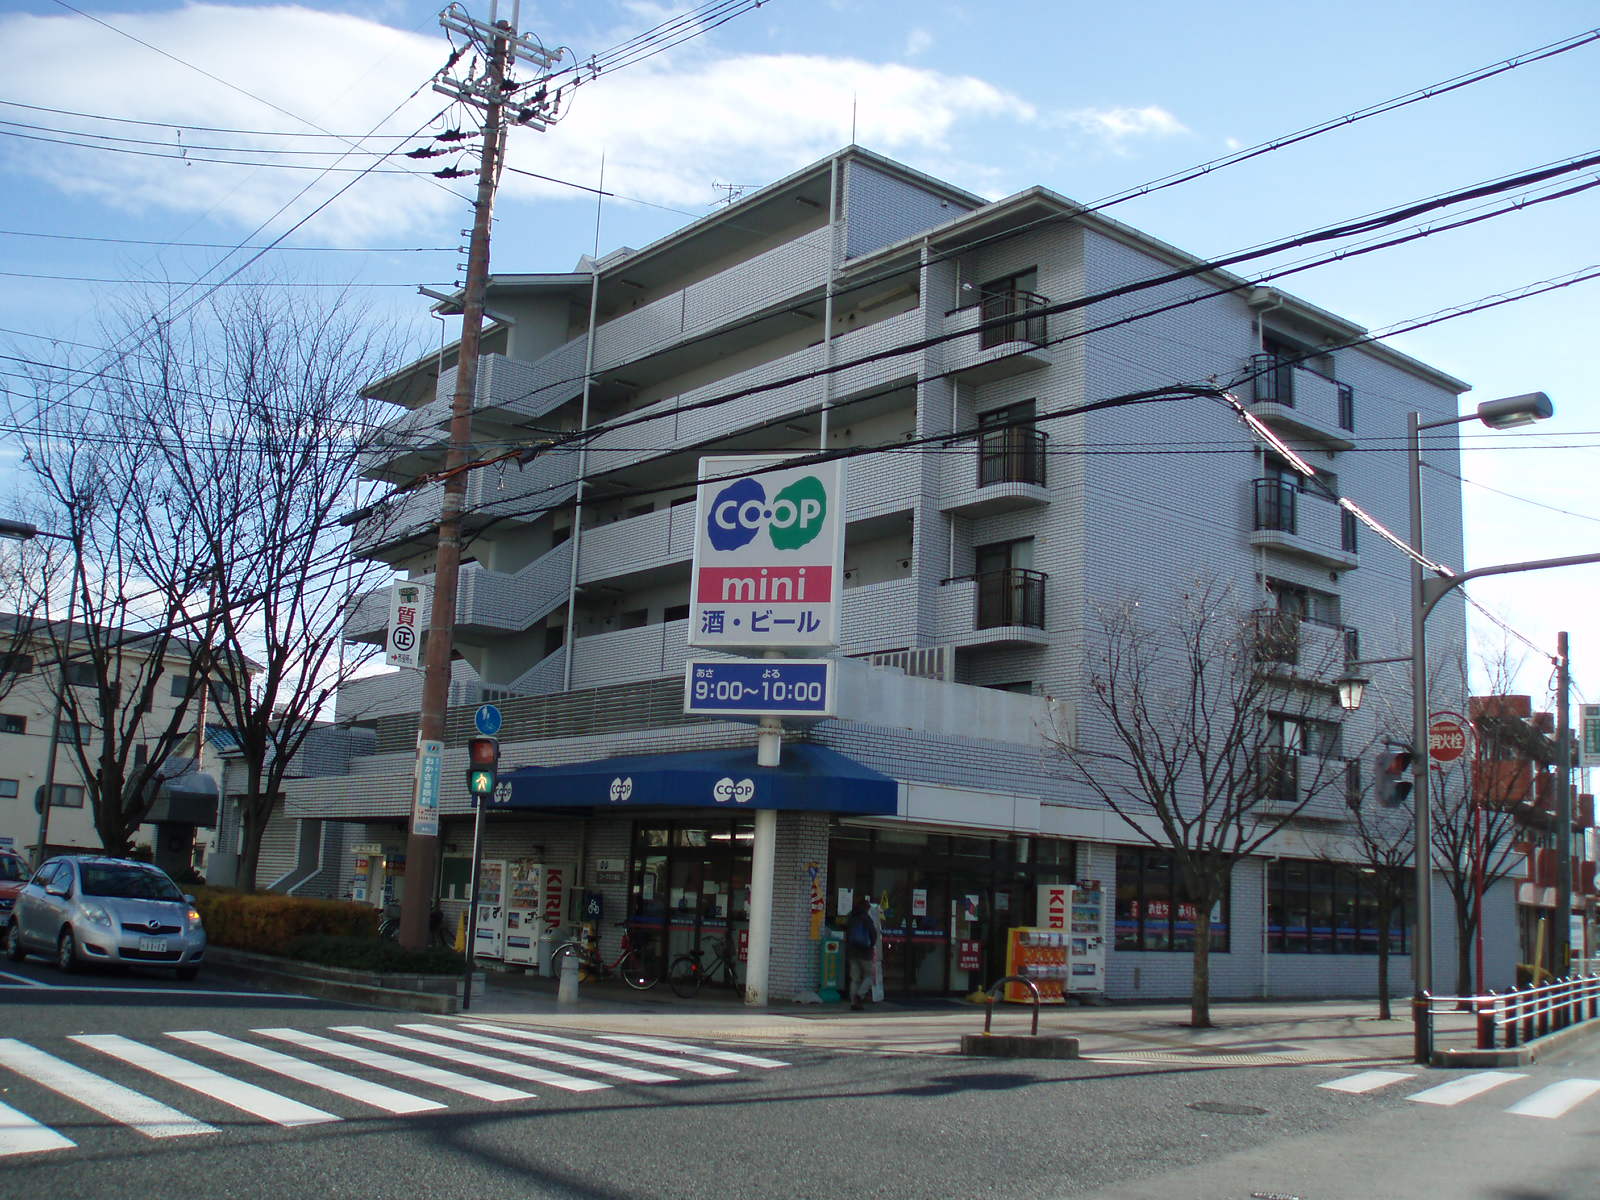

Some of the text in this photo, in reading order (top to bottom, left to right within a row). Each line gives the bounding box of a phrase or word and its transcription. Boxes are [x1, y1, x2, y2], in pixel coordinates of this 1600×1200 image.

[721, 568, 806, 601] mini
[397, 606, 417, 628] 質
[701, 610, 821, 634] 酒・ビール
[696, 668, 781, 679] あさ よる
